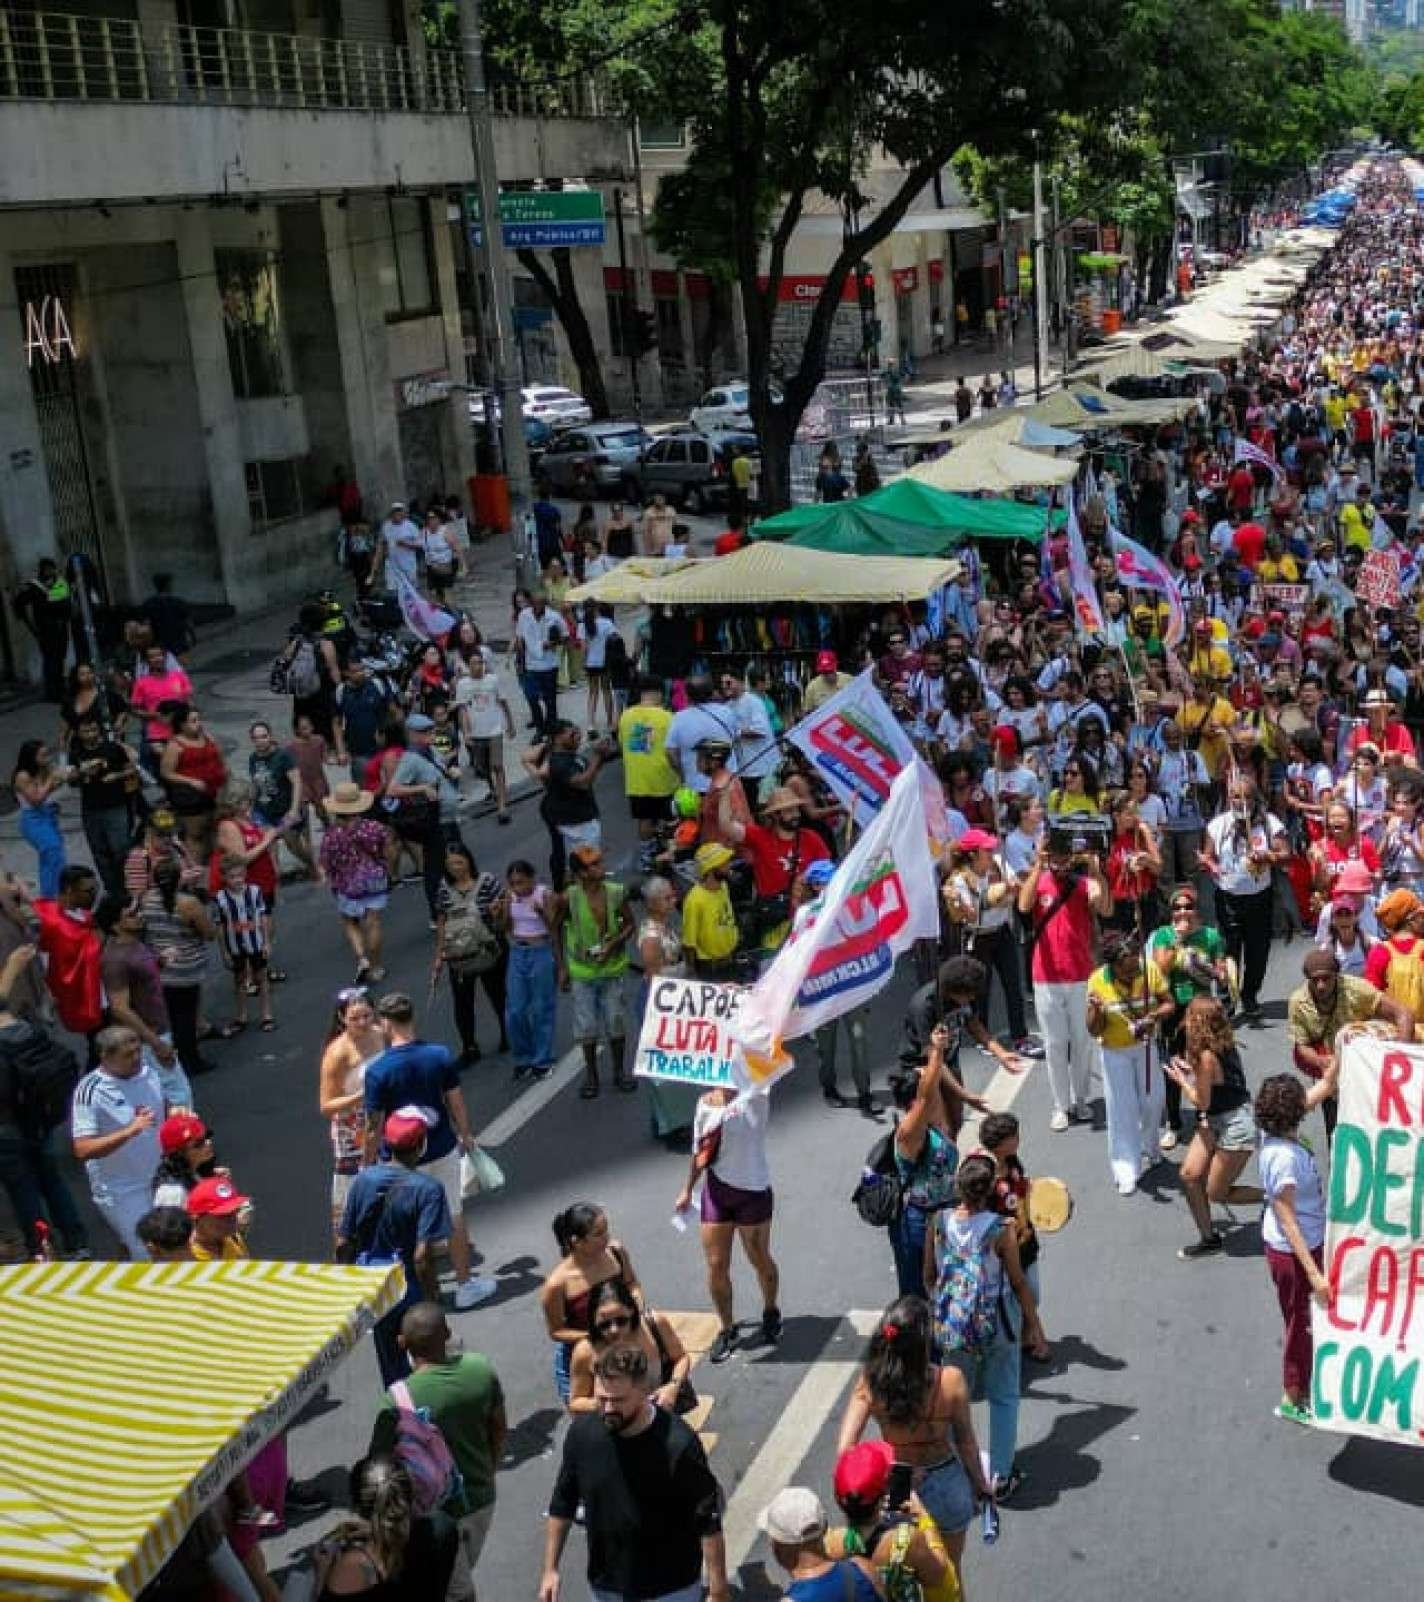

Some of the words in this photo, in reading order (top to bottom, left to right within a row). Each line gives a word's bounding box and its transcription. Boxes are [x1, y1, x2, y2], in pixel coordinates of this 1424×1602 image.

[655, 1015, 718, 1054] LUTA
[643, 1048, 734, 1083] TRABALH
[1312, 1340, 1419, 1430] COM
